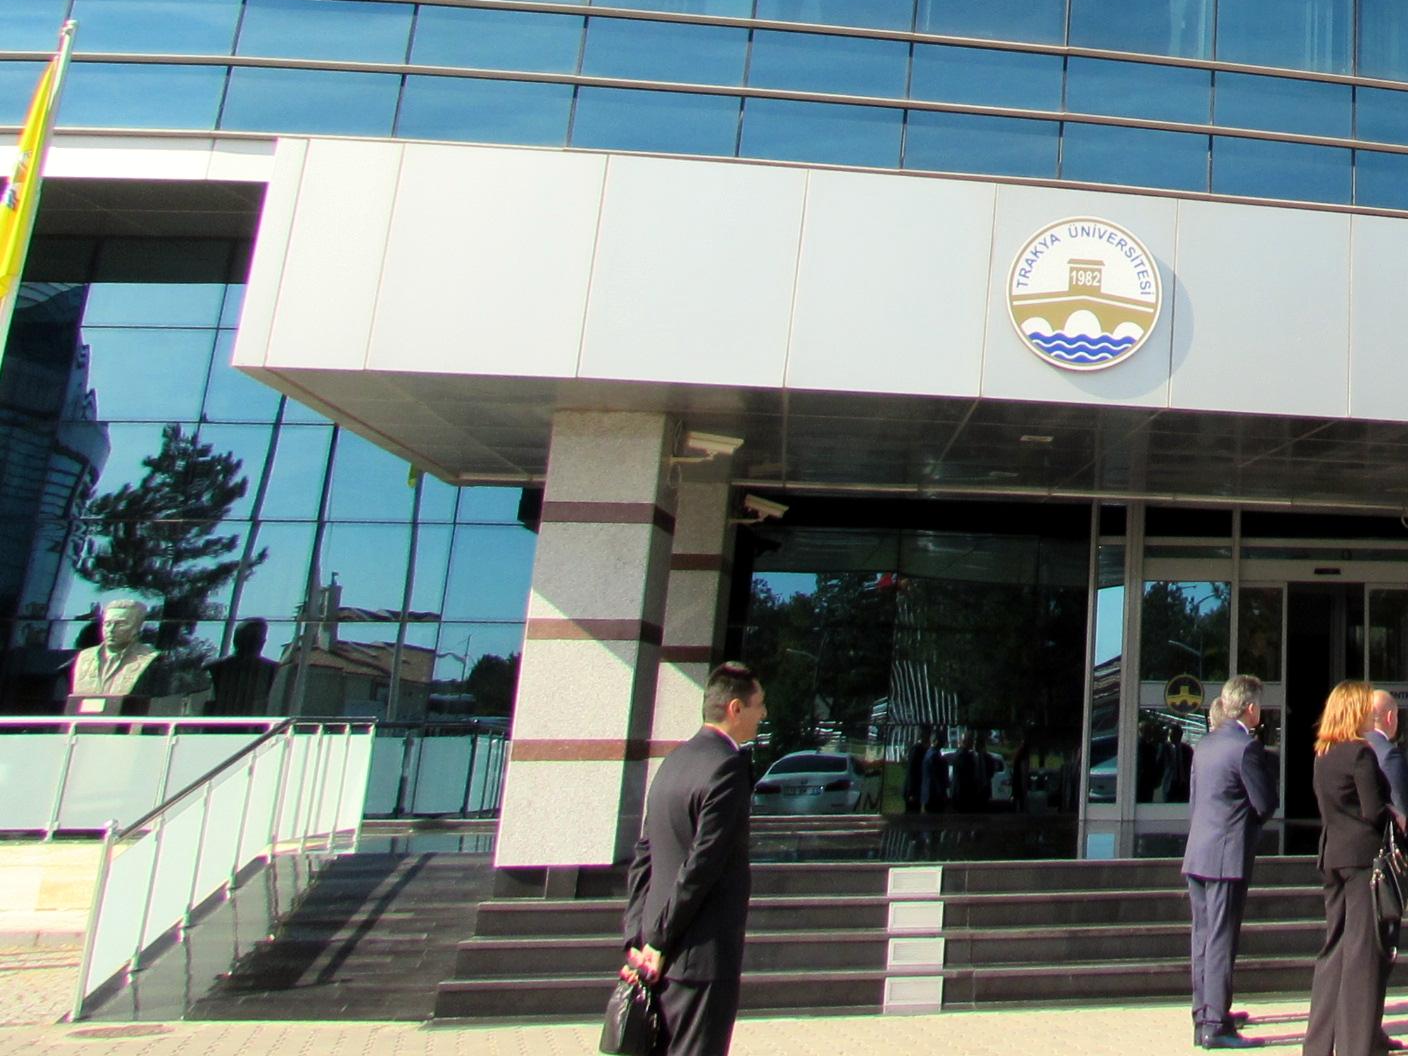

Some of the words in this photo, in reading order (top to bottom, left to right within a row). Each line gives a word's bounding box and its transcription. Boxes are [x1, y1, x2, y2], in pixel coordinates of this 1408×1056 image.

[1017, 233, 1061, 288] TRAKYA
[1068, 224, 1153, 295] ÜNİVERSİTESİ
[1071, 270, 1101, 286] 1982
